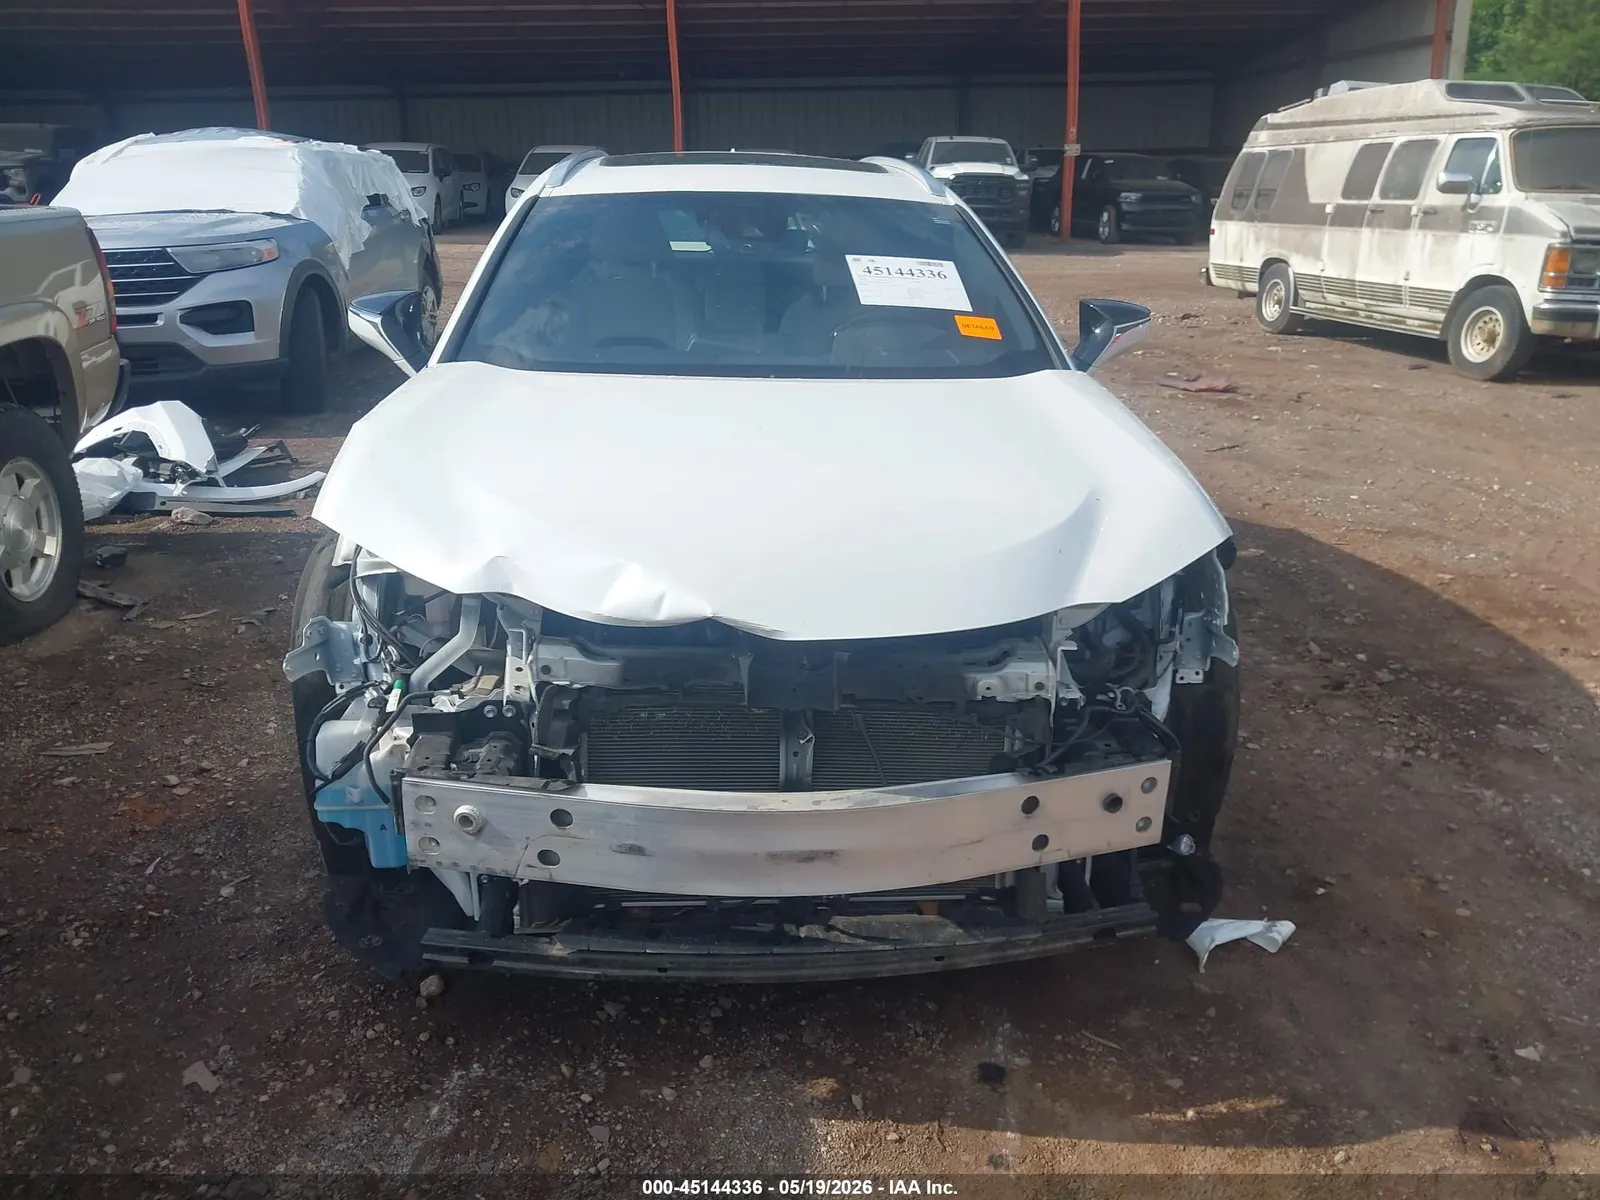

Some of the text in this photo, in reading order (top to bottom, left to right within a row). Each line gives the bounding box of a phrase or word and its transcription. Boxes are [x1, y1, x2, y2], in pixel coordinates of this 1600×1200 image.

[862, 265, 948, 280] 45144336
[961, 323, 995, 331] DETAILED
[380, 823, 388, 831] A
